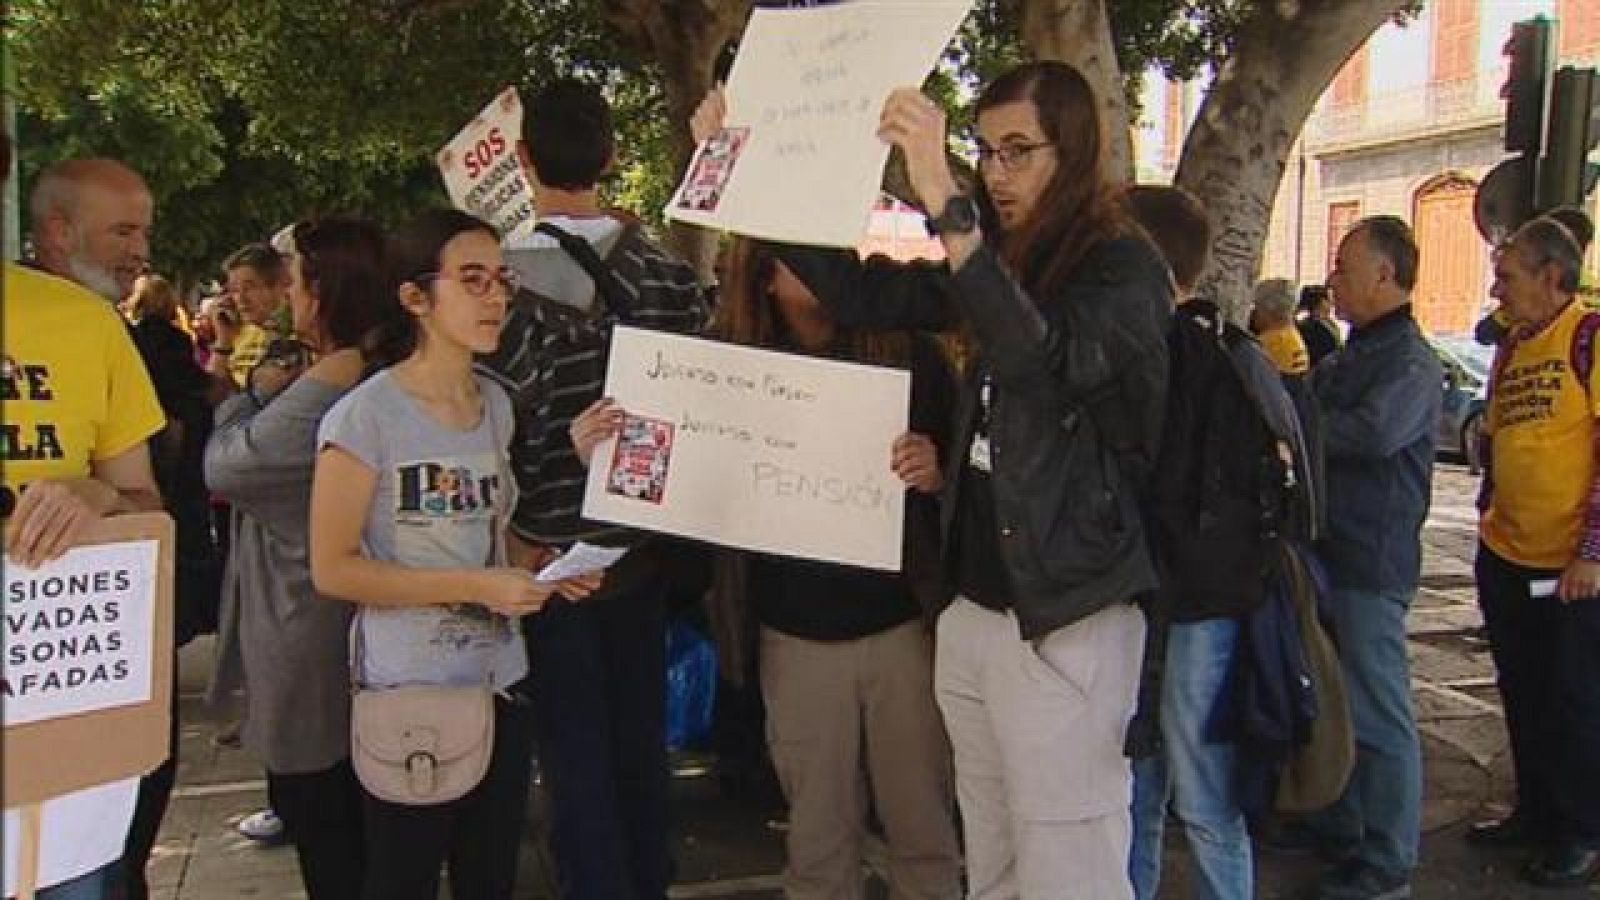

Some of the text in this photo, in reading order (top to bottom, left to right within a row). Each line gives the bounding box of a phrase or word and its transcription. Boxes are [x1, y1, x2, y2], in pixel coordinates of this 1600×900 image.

[464, 127, 506, 178] SOS
[9, 569, 131, 603] SIONES
[7, 601, 121, 634] VADAS
[9, 630, 123, 666] SONAS
